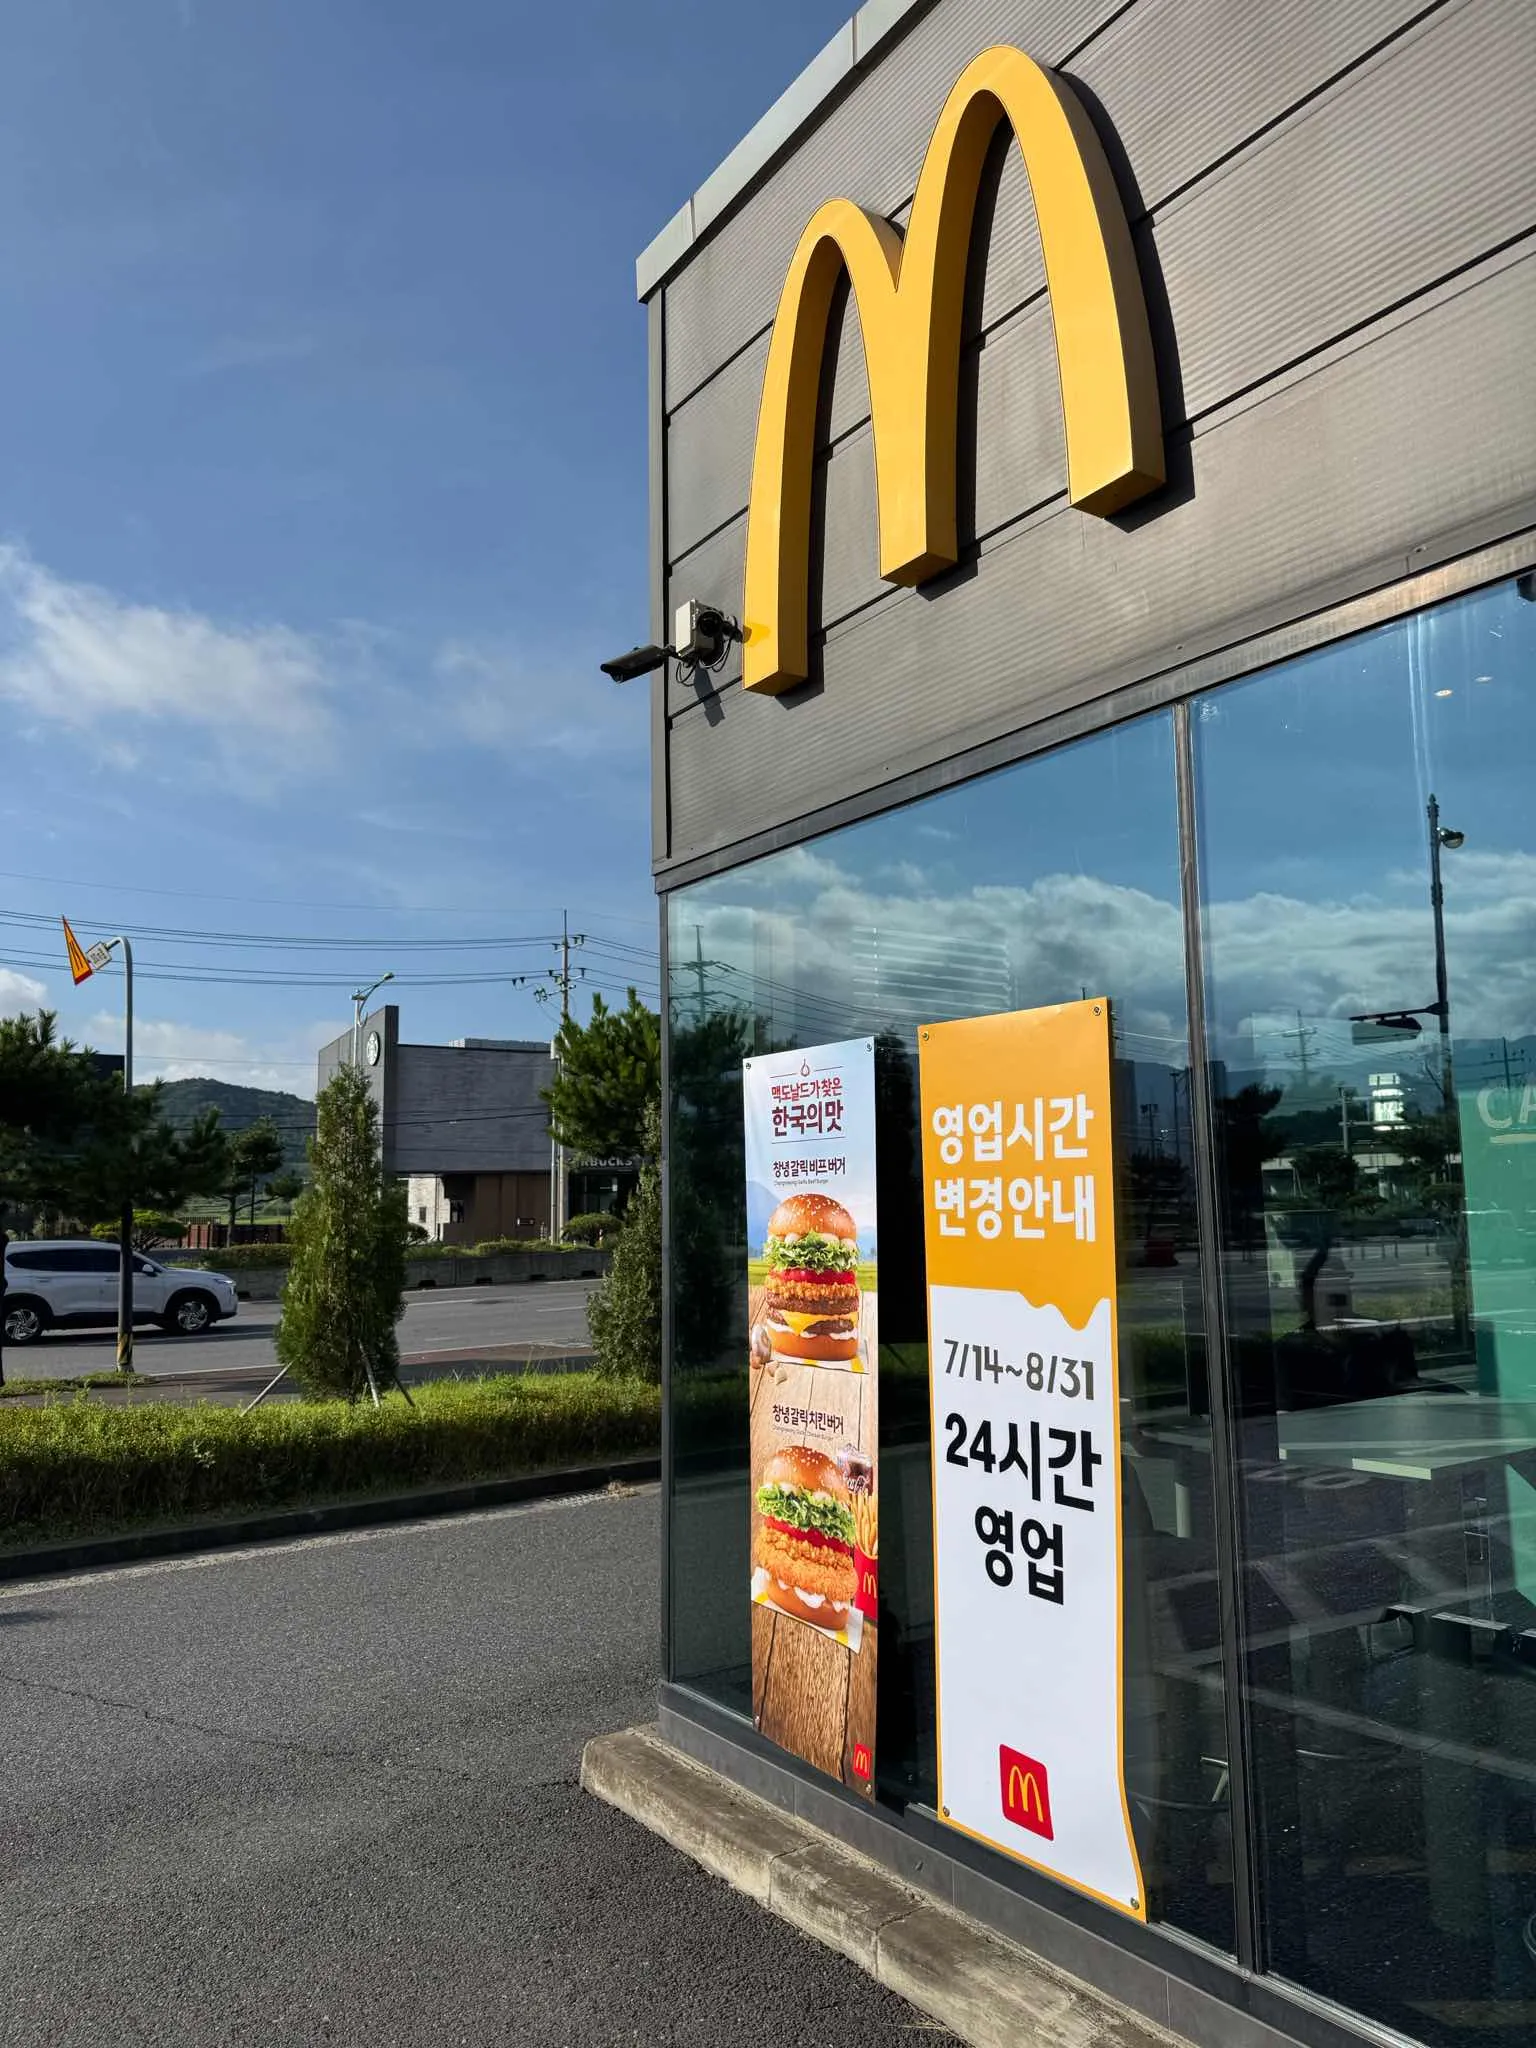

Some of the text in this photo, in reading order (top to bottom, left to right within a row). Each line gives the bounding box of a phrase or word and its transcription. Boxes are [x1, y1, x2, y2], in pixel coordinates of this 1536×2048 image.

[771, 1077, 842, 1103] 맥도날드가 찾은
[932, 1094, 1094, 1165] 영업시간
[934, 1175, 1096, 1242] 변경안내
[944, 1339, 1094, 1400] 7/14~8/31
[945, 1412, 1102, 1512] 24시간
[974, 1505, 1064, 1605] 영업
